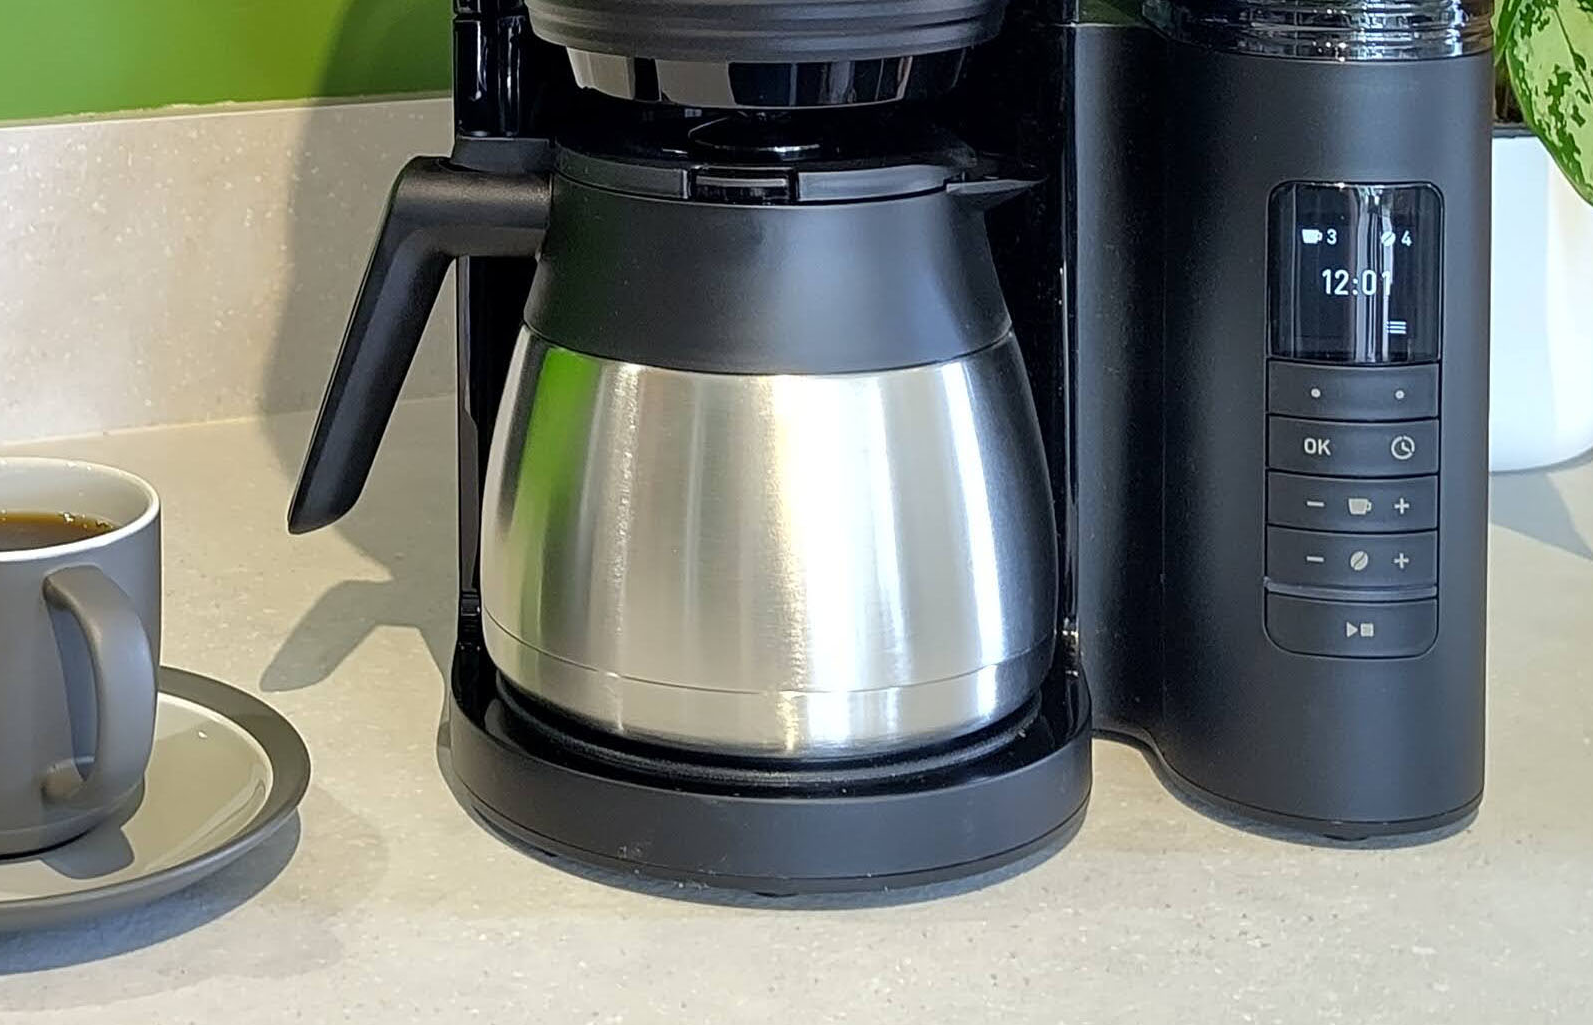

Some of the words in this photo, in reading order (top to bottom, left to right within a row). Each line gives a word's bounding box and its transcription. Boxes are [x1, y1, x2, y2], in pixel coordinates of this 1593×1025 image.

[1327, 228, 1337, 245] 3
[1401, 230, 1412, 247] 4
[1322, 269, 1392, 296] 12:01
[1303, 438, 1331, 456] OK
